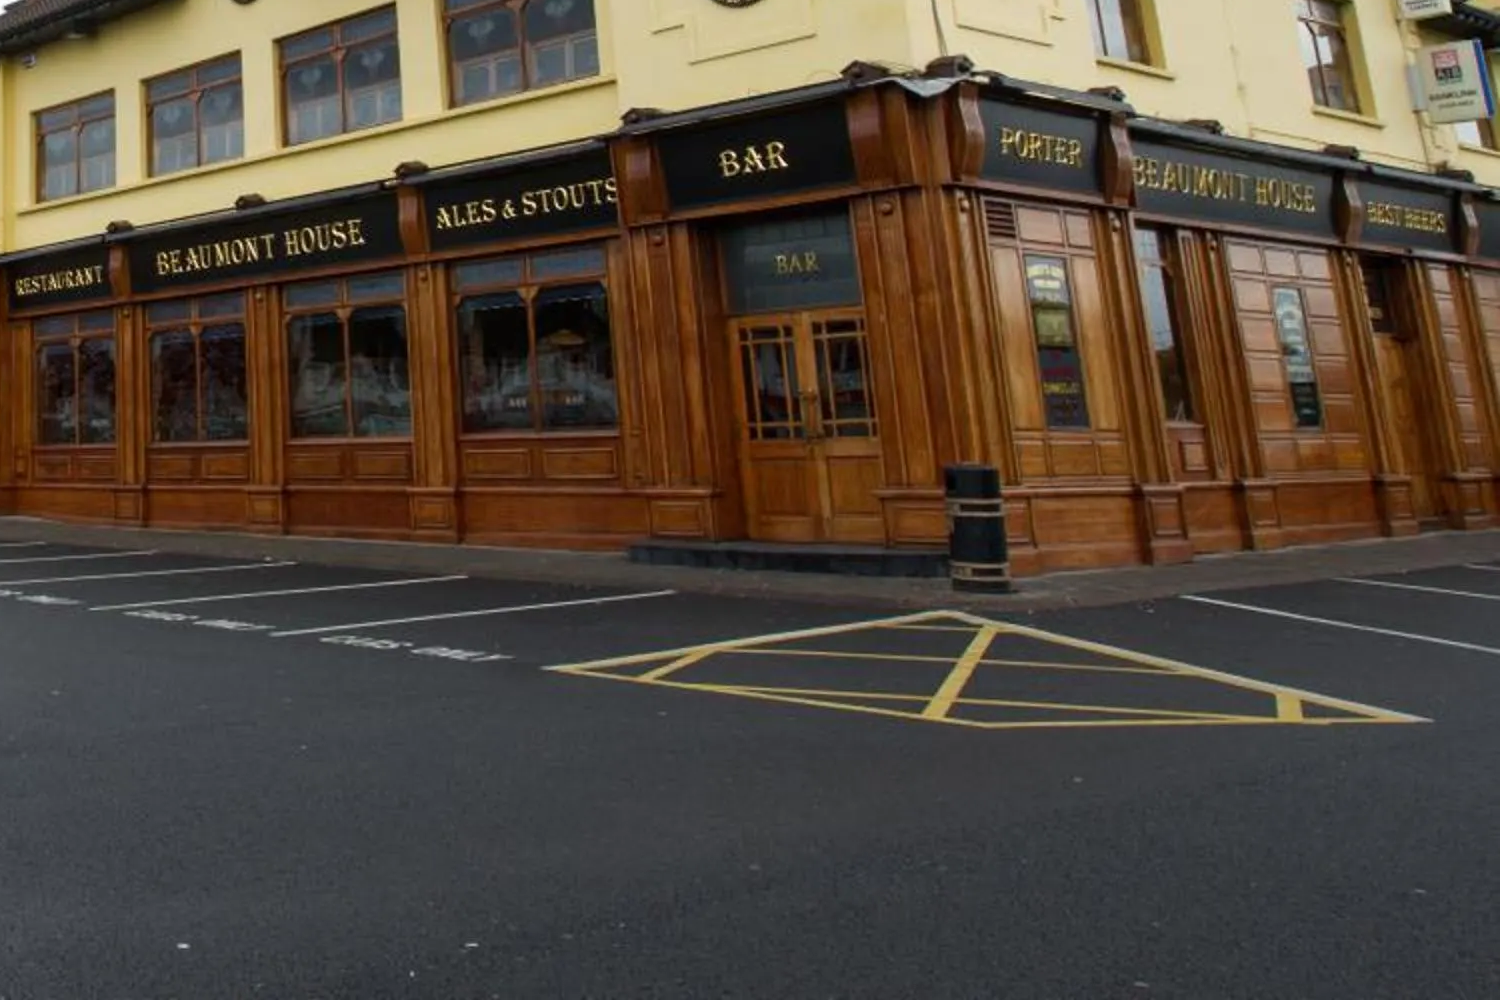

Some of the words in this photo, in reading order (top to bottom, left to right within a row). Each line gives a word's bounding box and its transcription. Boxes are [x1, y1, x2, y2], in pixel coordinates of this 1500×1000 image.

[719, 141, 789, 177] BAR
[1001, 126, 1082, 168] PORTER
[436, 199, 497, 230] ALES
[502, 199, 516, 219] &
[521, 176, 617, 216] STOUTS
[1132, 155, 1248, 201] BEAUMONT
[1255, 177, 1316, 213] HOUSE
[156, 233, 275, 275] BEAUMONT
[284, 219, 365, 256] HOUSE
[776, 251, 820, 274] BAR
[15, 265, 103, 296] RESTAURANT
